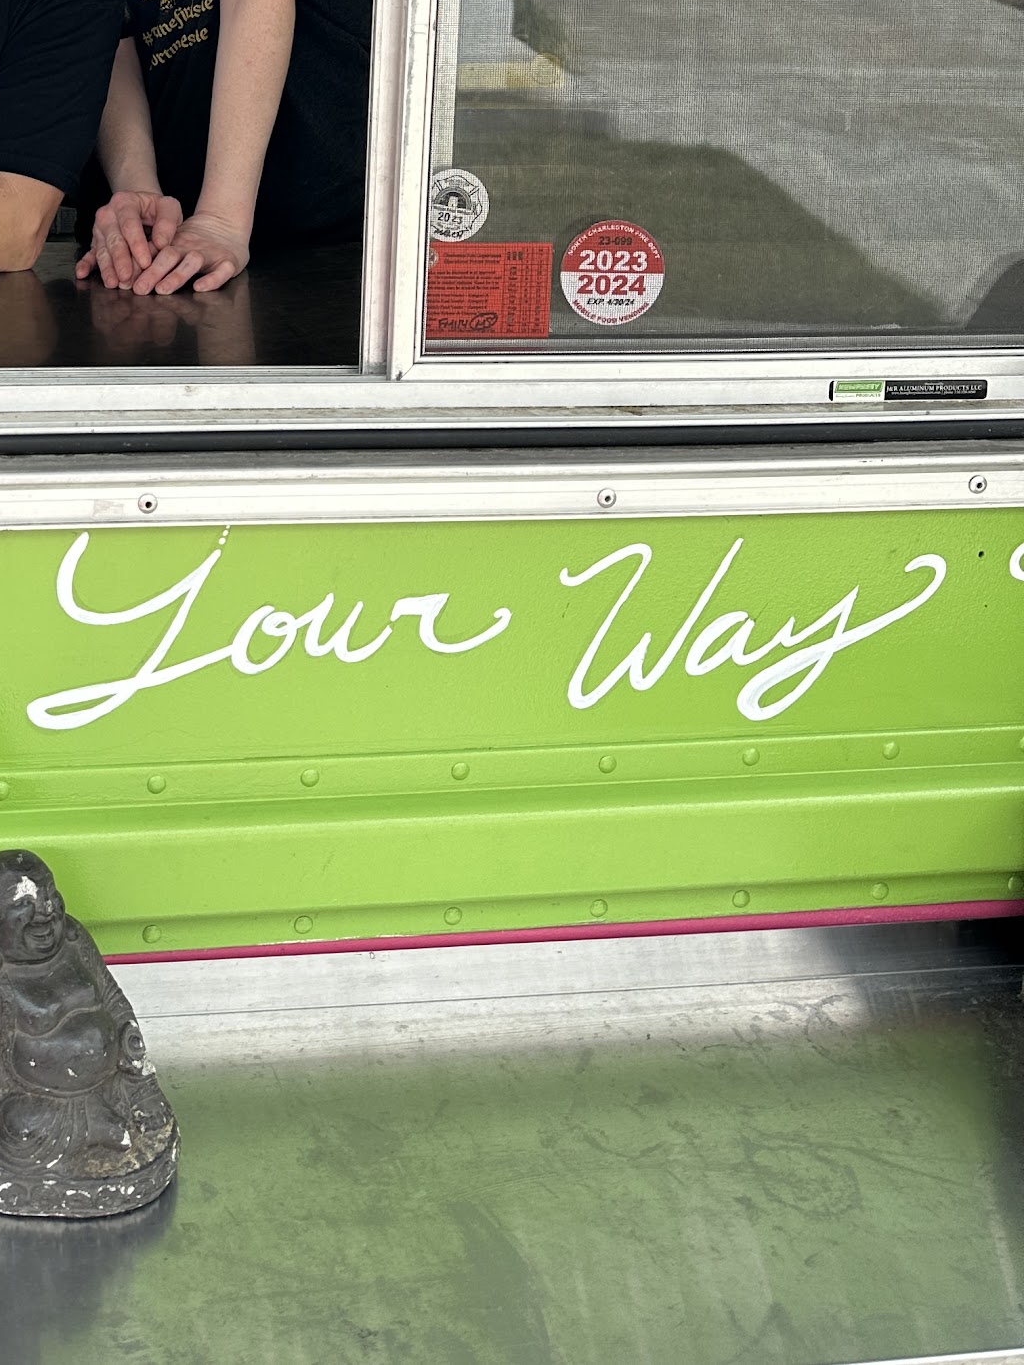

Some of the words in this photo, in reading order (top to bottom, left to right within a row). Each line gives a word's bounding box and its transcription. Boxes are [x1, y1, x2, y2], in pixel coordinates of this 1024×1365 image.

[568, 235, 588, 256] NORTH
[588, 224, 635, 237] CHARLESTON
[634, 230, 650, 243] FIRE
[598, 236, 633, 246] 23-099
[578, 250, 648, 272] 2023
[577, 274, 646, 296] 2024
[572, 299, 596, 320] MOBILE
[597, 316, 618, 324] FOOD
[619, 302, 650, 322] VENDING
[607, 298, 636, 306] 4/30/24
[886, 385, 898, 393] J&R
[899, 384, 935, 392] ALUMINUM
[935, 384, 970, 392] PRODUCTS
[26, 526, 511, 730] Your
[559, 538, 946, 721] Way
